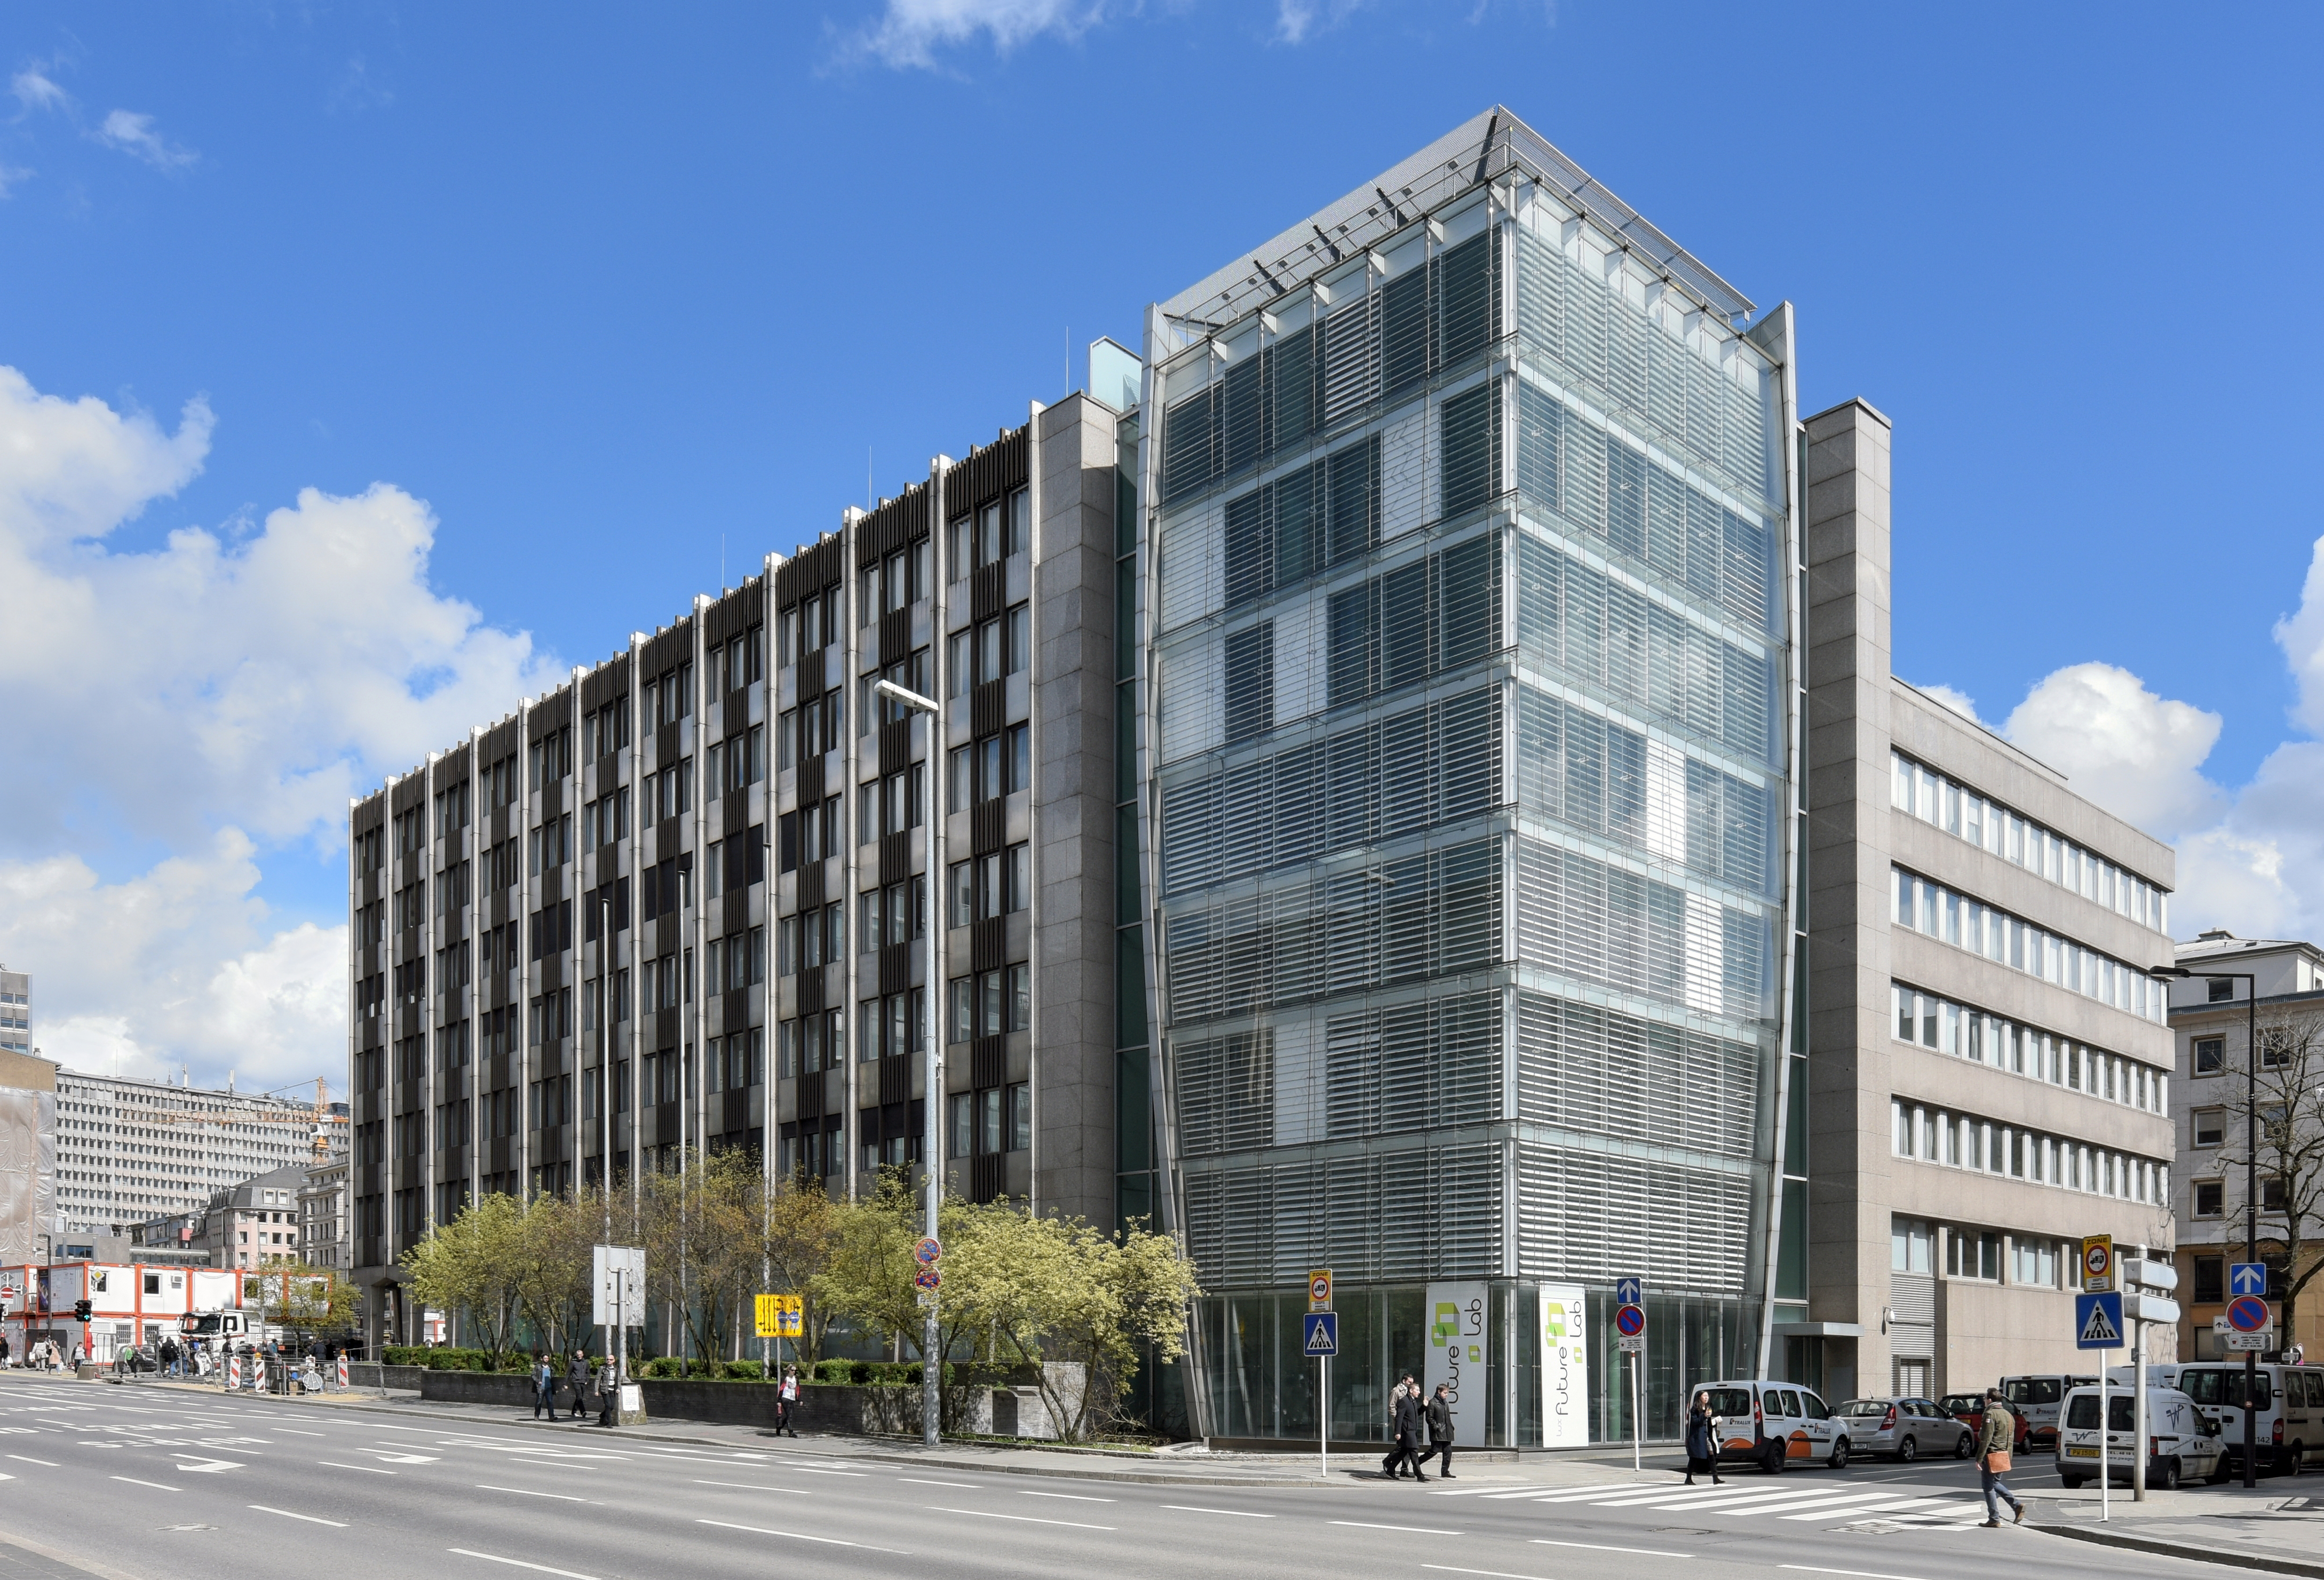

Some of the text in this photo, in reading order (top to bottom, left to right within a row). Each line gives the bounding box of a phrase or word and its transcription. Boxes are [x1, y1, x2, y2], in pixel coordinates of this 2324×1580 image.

[1448, 1346, 1459, 1414] uture
[1556, 1347, 1568, 1415] future
[77, 1438, 274, 1448] AUTRES
